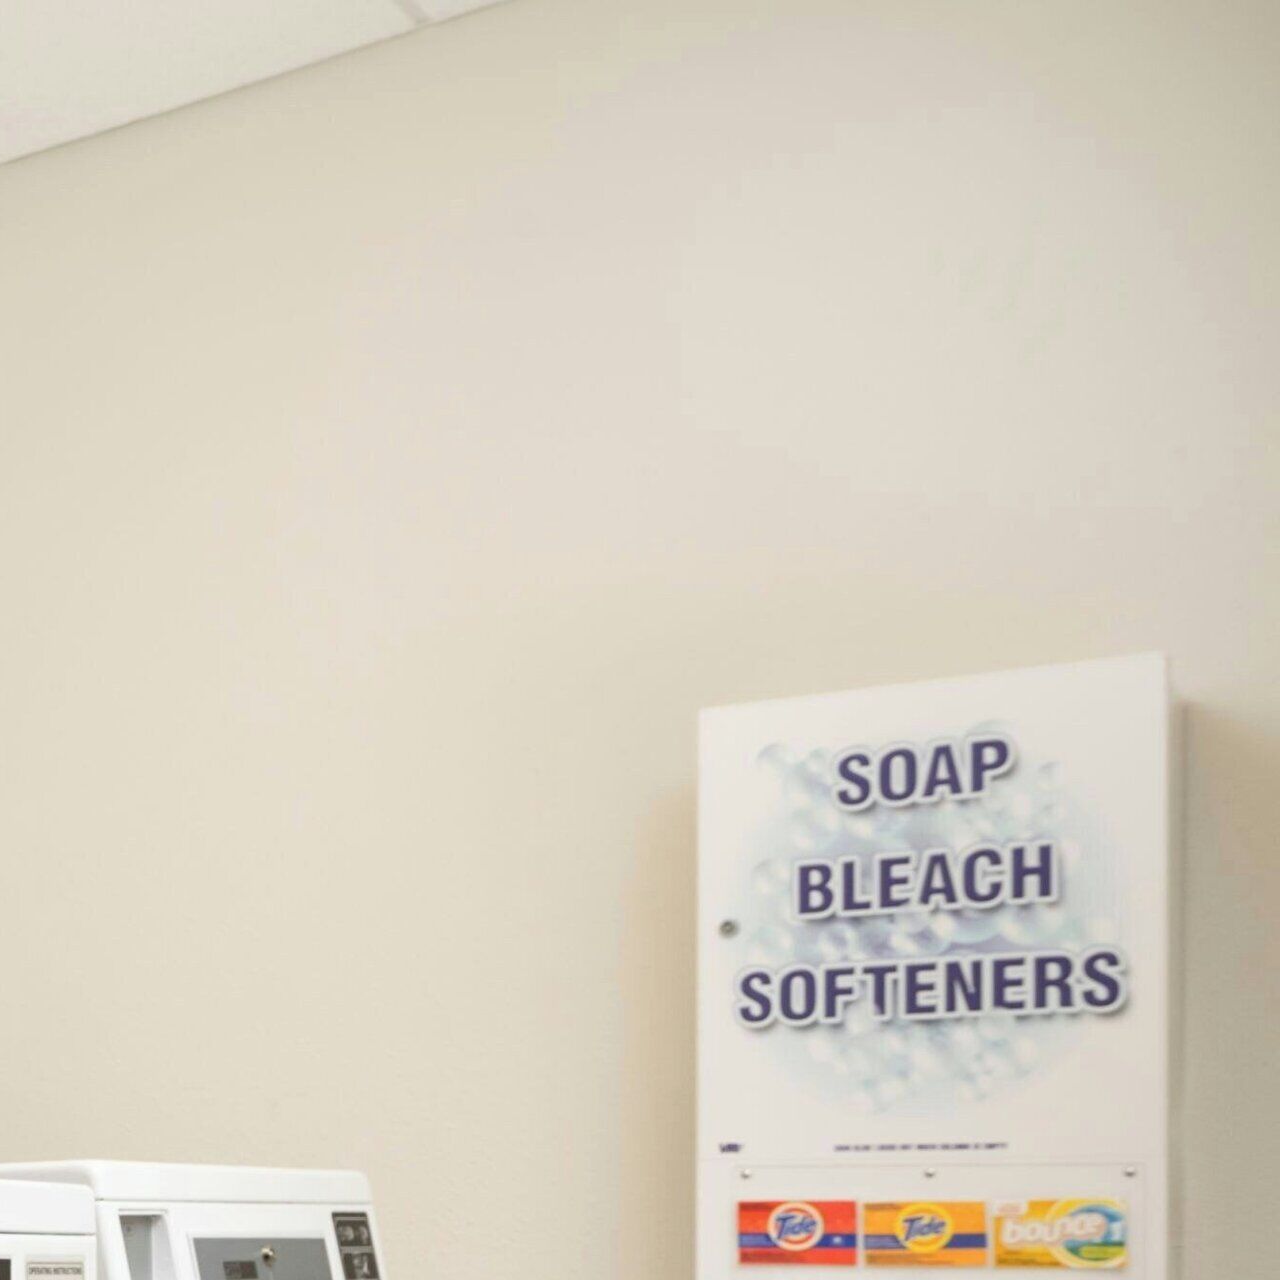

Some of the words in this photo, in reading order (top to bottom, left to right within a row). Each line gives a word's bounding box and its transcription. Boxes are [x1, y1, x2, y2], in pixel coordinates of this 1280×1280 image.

[836, 739, 1010, 806] SOAP
[797, 843, 1054, 916] BLEACH
[739, 951, 1122, 1024] SOFTENERS
[775, 1213, 817, 1240] Tide
[902, 1215, 946, 1243] Tide
